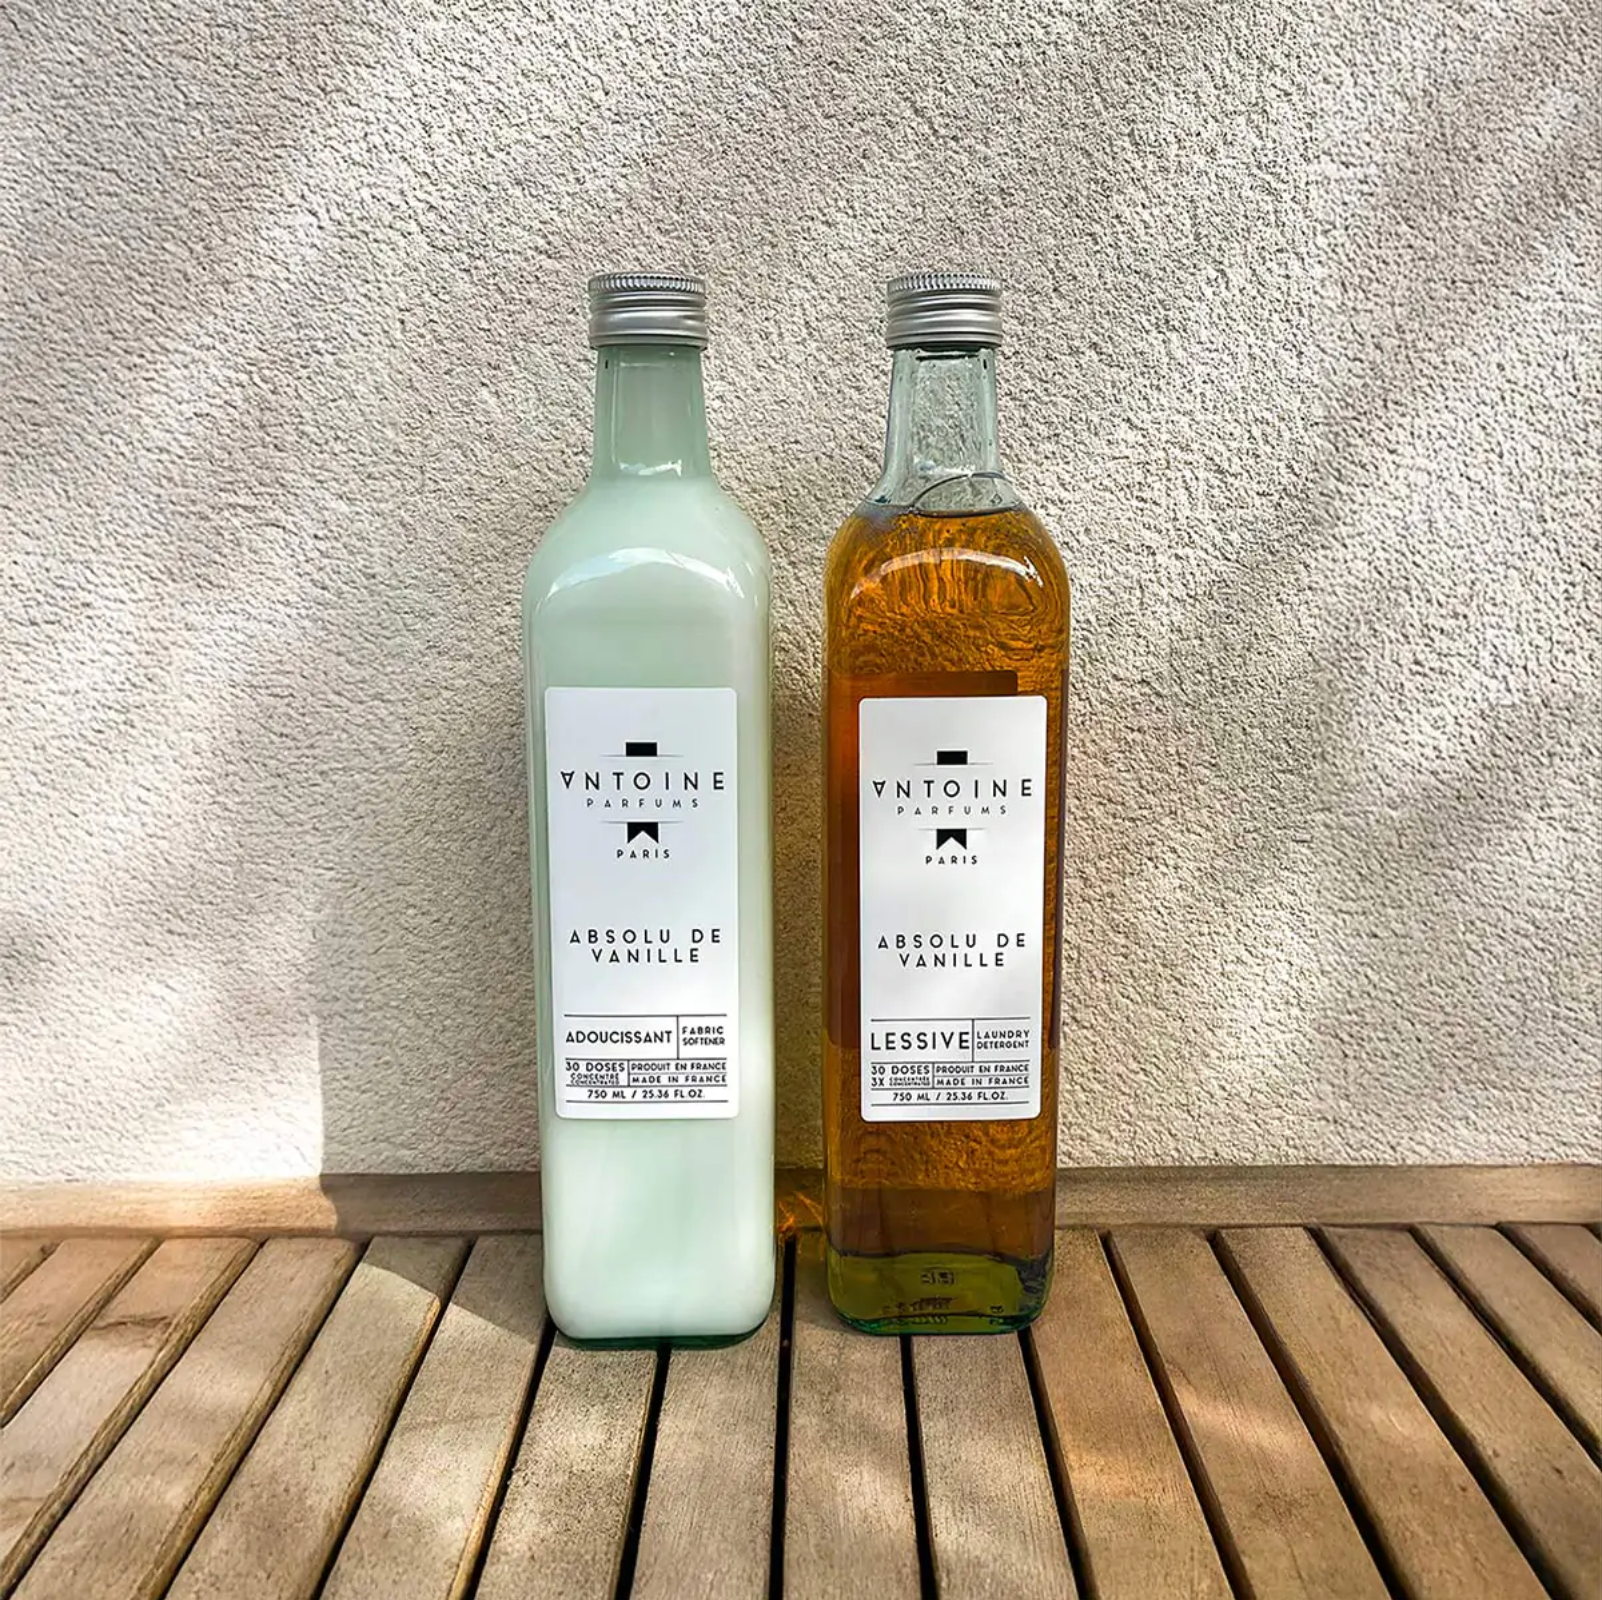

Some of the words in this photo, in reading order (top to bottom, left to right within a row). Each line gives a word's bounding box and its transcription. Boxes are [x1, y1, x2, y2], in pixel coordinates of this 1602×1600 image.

[587, 798, 697, 808] PARFUMS
[898, 806, 1006, 815] PARFUMS
[617, 849, 669, 858] PARIS
[926, 856, 977, 864] PARIS
[570, 929, 669, 944] ABSOLU
[692, 929, 720, 943] DE
[878, 934, 976, 949] ABSOLU
[997, 933, 1024, 947] DE
[592, 948, 698, 963] VANILLE
[899, 953, 1003, 967] VANILLE
[682, 1026, 723, 1035] FABRIC
[977, 1030, 1029, 1039] LAUNDRY
[566, 1031, 672, 1043] ADOUCISSANT
[683, 1037, 725, 1045] SOFTENER
[871, 1032, 969, 1050] LESSIVE
[977, 1040, 1029, 1049] DETERGENT
[566, 1061, 579, 1071] 30
[586, 1062, 625, 1072] DOSES
[631, 1063, 670, 1071] PRODUIT
[675, 1063, 687, 1071] EN
[872, 1066, 885, 1075] 30
[892, 1065, 929, 1075] DOSES
[936, 1065, 974, 1073] PRODUIT
[979, 1065, 990, 1073] EN
[995, 1064, 1028, 1072] FRANCE
[685, 1074, 726, 1083] FRANCE
[872, 1077, 884, 1087] 3X
[937, 1078, 965, 1086] MADE
[989, 1076, 1028, 1086] FRANCE
[588, 1089, 607, 1099] 750
[612, 1090, 625, 1099] ML
[632, 1090, 637, 1098] /
[642, 1090, 669, 1098] 25.36
[893, 1092, 912, 1101] 750
[917, 1093, 930, 1101] ML
[936, 1092, 941, 1100] /
[947, 1092, 972, 1100] 25.36
